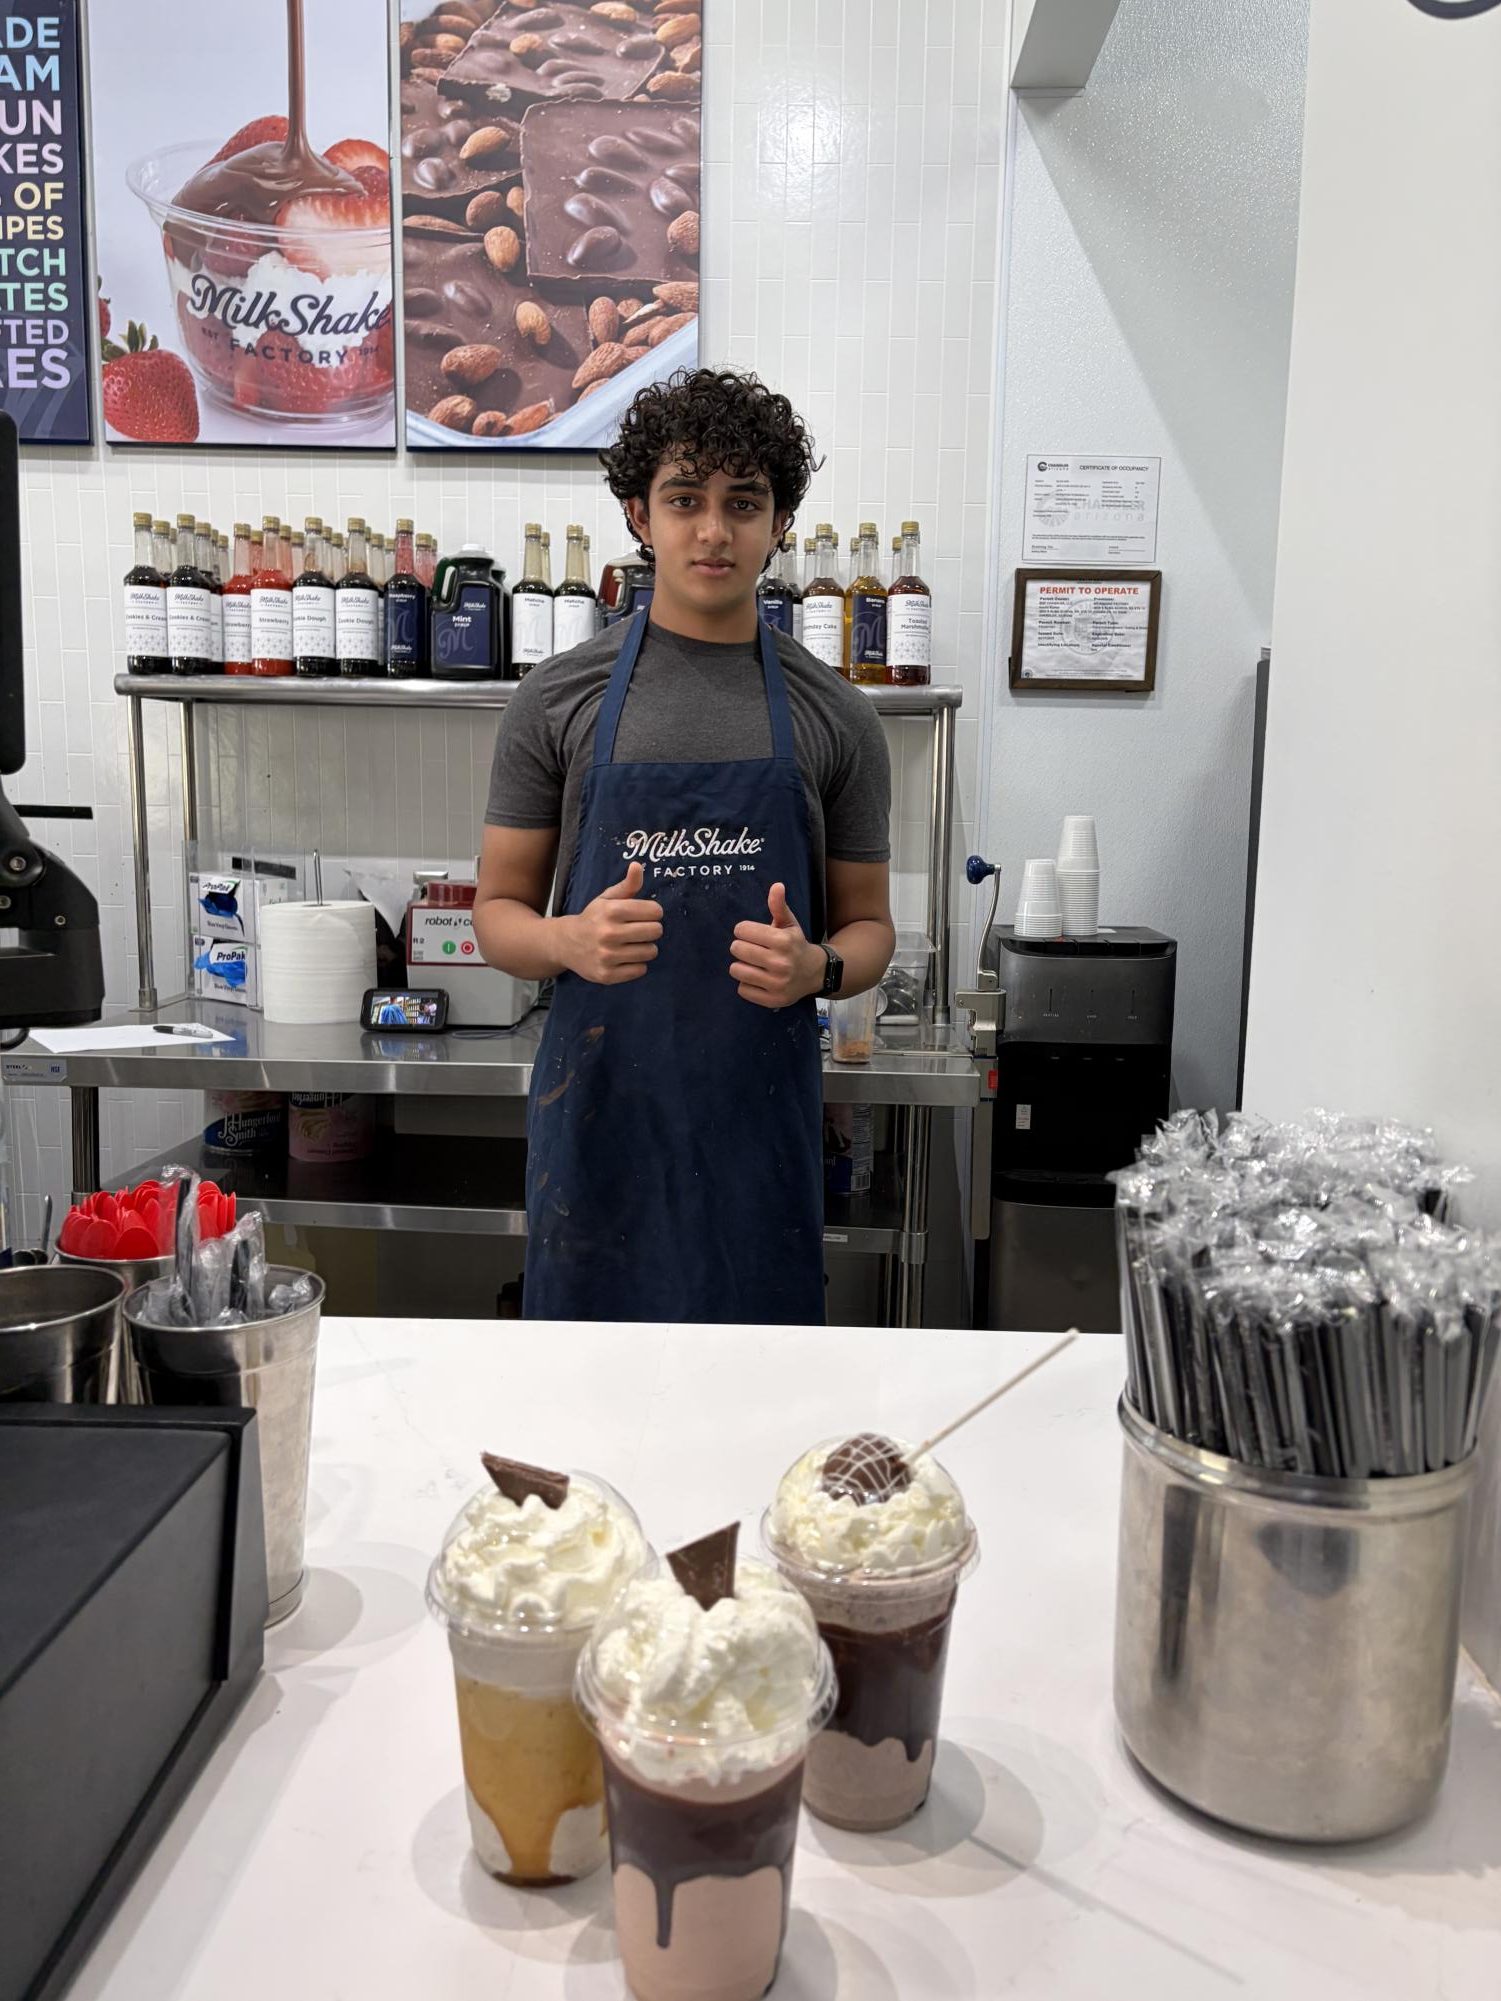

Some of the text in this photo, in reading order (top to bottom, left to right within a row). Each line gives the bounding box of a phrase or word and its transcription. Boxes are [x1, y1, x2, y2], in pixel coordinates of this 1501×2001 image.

[0, 17, 60, 48] DE
[14, 182, 64, 210] OF
[0, 282, 69, 312] TES
[191, 274, 391, 337] MilkShake
[0, 319, 69, 345] TED
[230, 338, 347, 364] FACTORY
[0, 348, 71, 389] ES
[1040, 586, 1139, 595] PERMIT TO OPERATE
[623, 826, 762, 863] MilkShake
[653, 864, 733, 878] FACTORY
[425, 916, 452, 926] robot
[216, 951, 246, 961] ProPak
[225, 1126, 257, 1147] Smith
